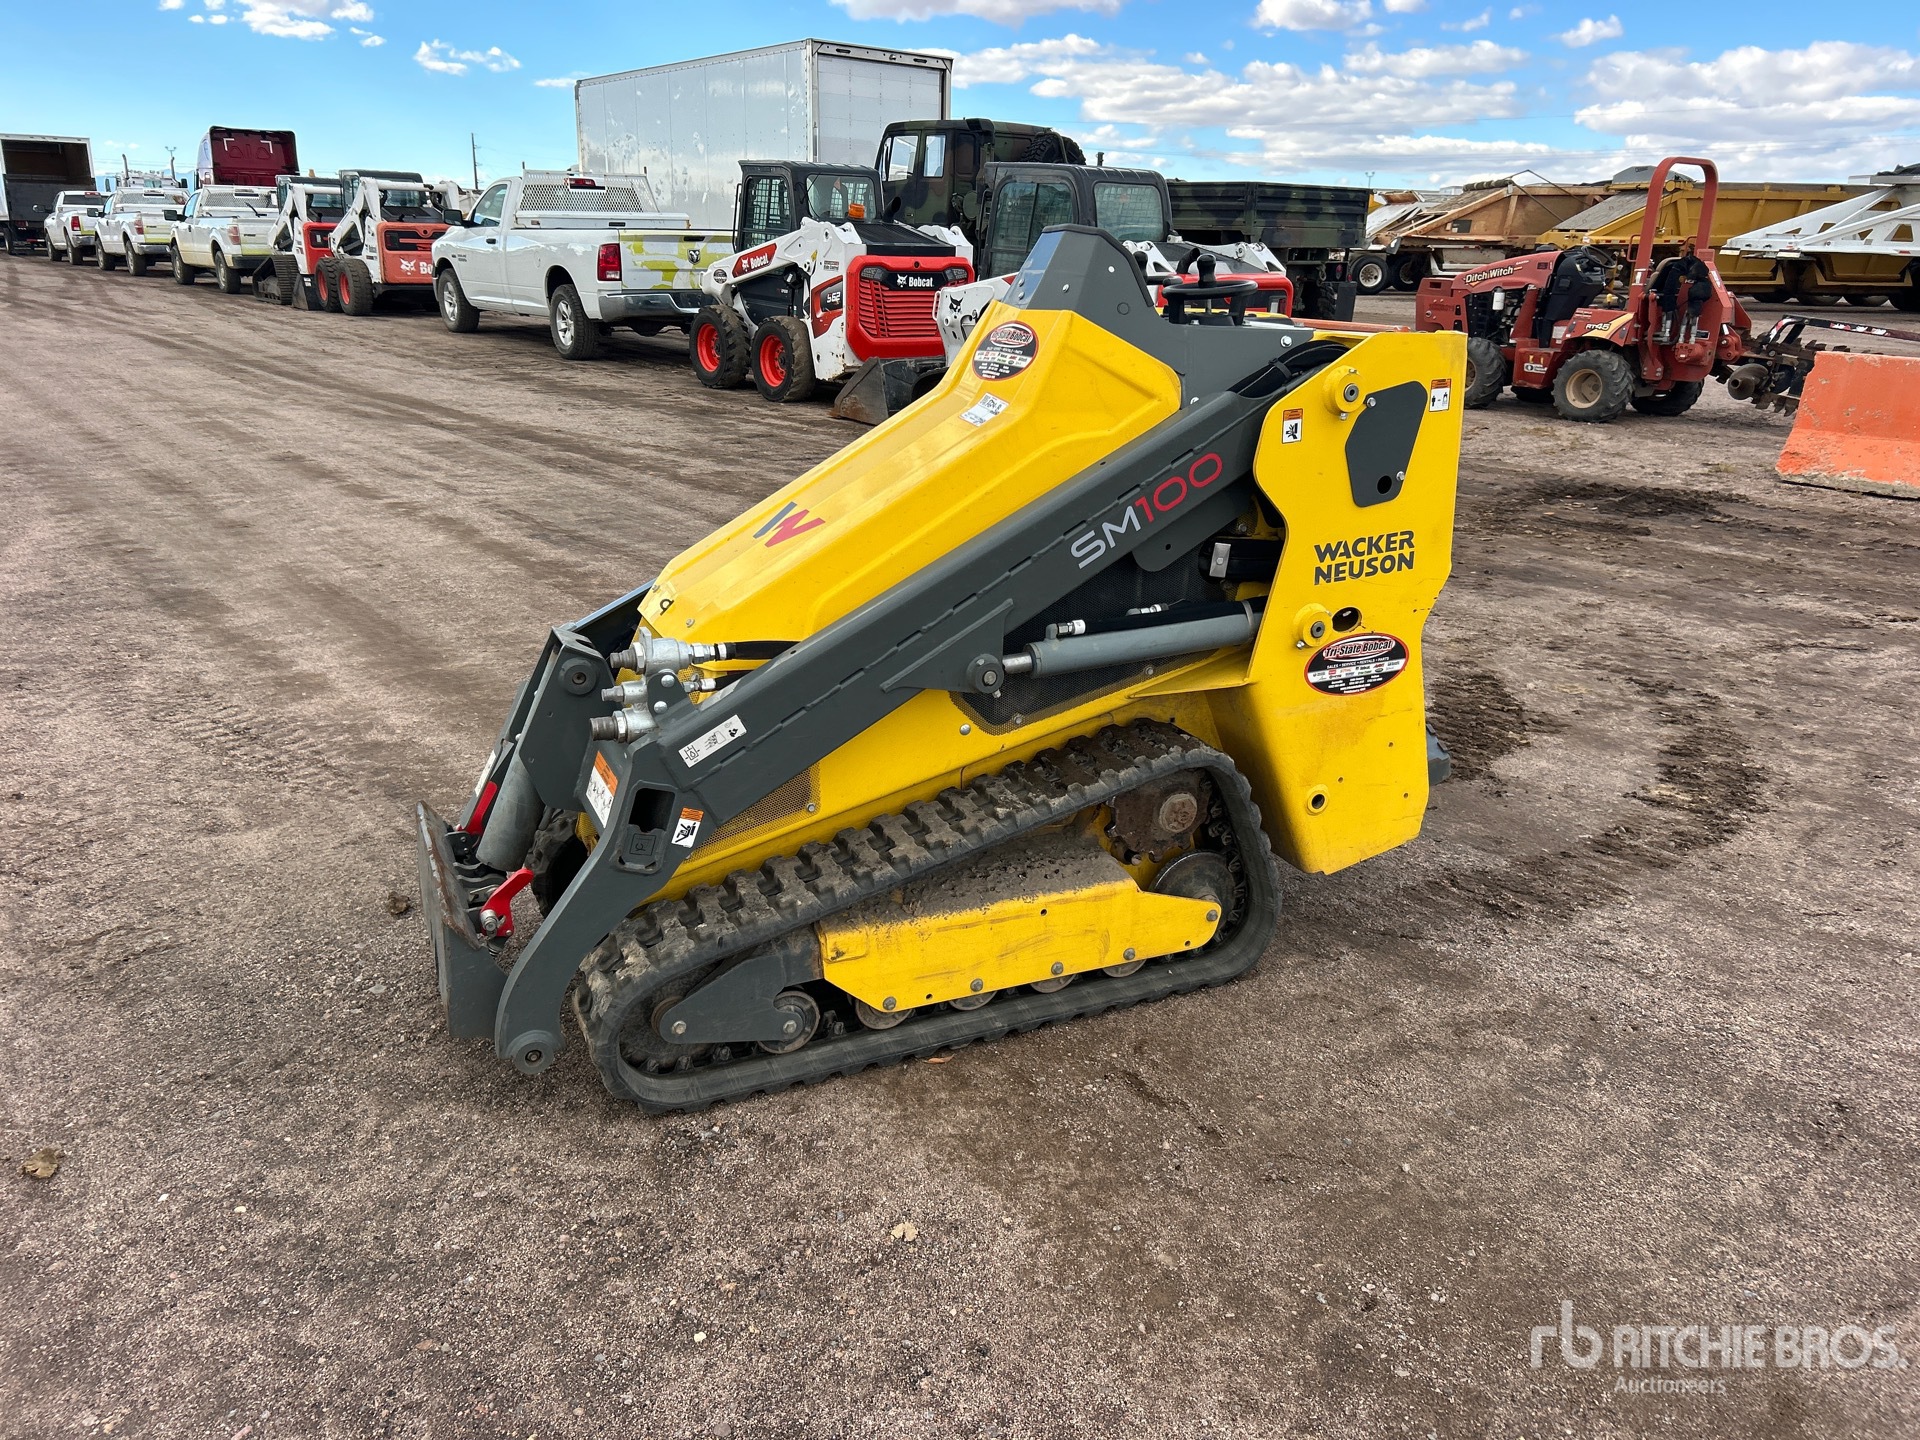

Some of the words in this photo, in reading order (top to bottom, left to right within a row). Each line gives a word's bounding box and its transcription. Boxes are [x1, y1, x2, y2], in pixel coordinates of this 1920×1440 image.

[750, 253, 769, 269] Bobcat
[908, 276, 934, 288] Bobcat
[1465, 271, 1488, 283] Ditch
[1489, 265, 1514, 278] Witch
[827, 291, 841, 303] S62
[1071, 452, 1223, 570] SM100
[1313, 530, 1415, 563] WACKER
[1313, 551, 1415, 586] NEUSON
[1325, 644, 1362, 658] Tri-State
[1362, 639, 1392, 653] Bobcat
